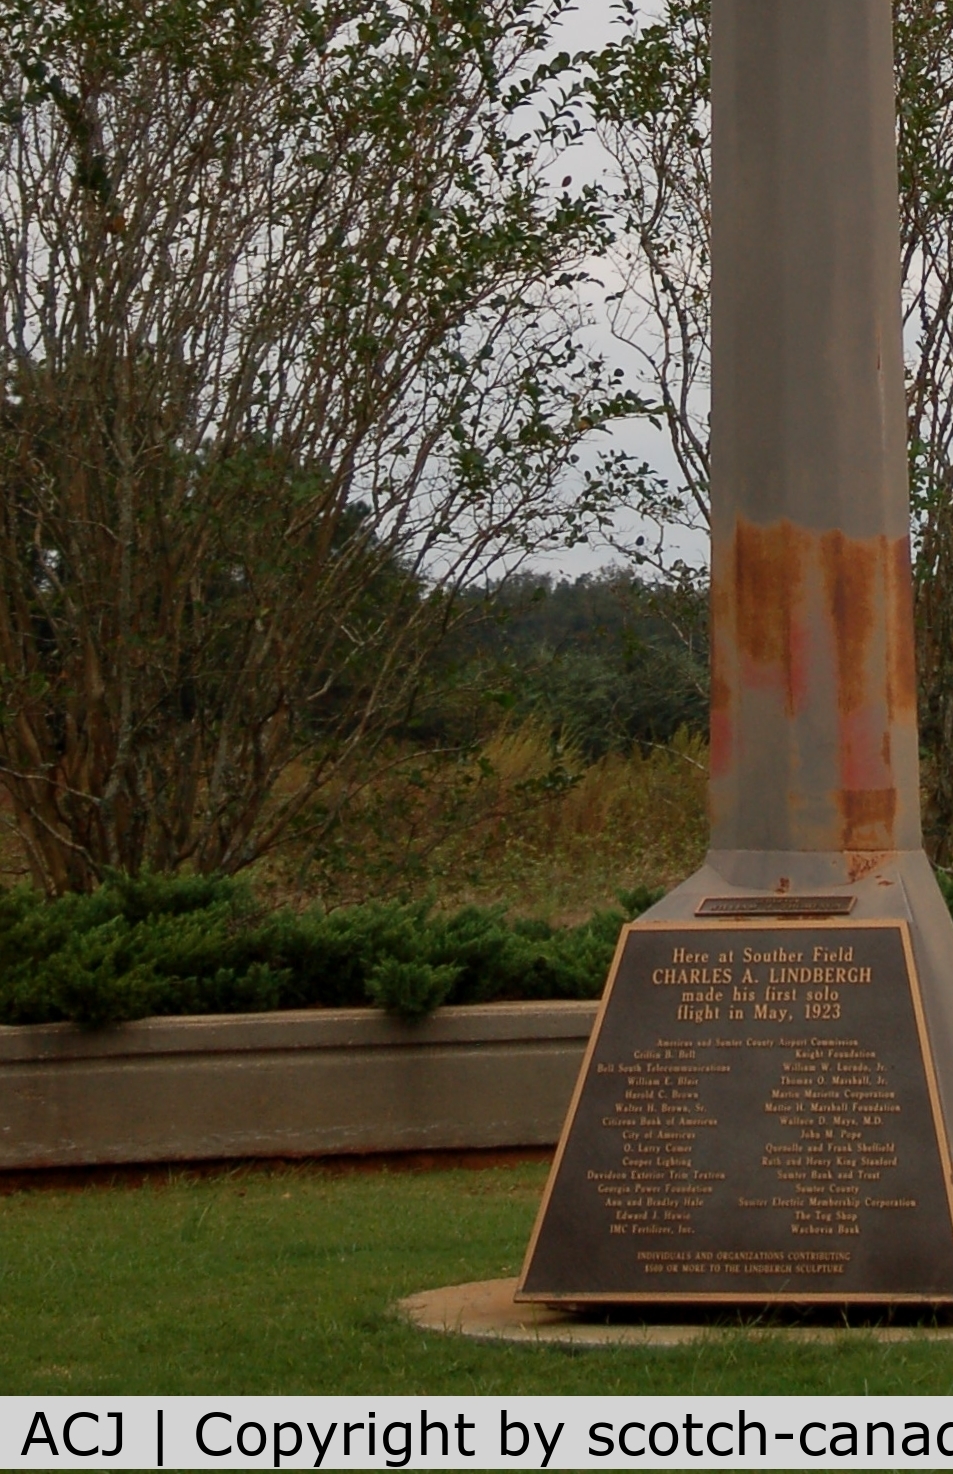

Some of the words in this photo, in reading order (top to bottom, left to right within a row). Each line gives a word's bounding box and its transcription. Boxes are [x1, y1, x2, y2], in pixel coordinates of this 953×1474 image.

[673, 948, 708, 963] Here
[719, 951, 733, 962] at
[743, 947, 802, 962] Souther
[813, 947, 852, 961] Field
[653, 968, 731, 985] CHARLES
[741, 969, 759, 983] A.
[770, 968, 871, 985] LINDBERGH
[682, 987, 723, 1003] made
[733, 986, 755, 1003] his
[766, 986, 796, 1003] first
[807, 986, 838, 1003] solo
[678, 1005, 719, 1022] flight
[730, 1005, 743, 1019] in
[754, 1004, 792, 1022] May,
[806, 1004, 840, 1018] 1923
